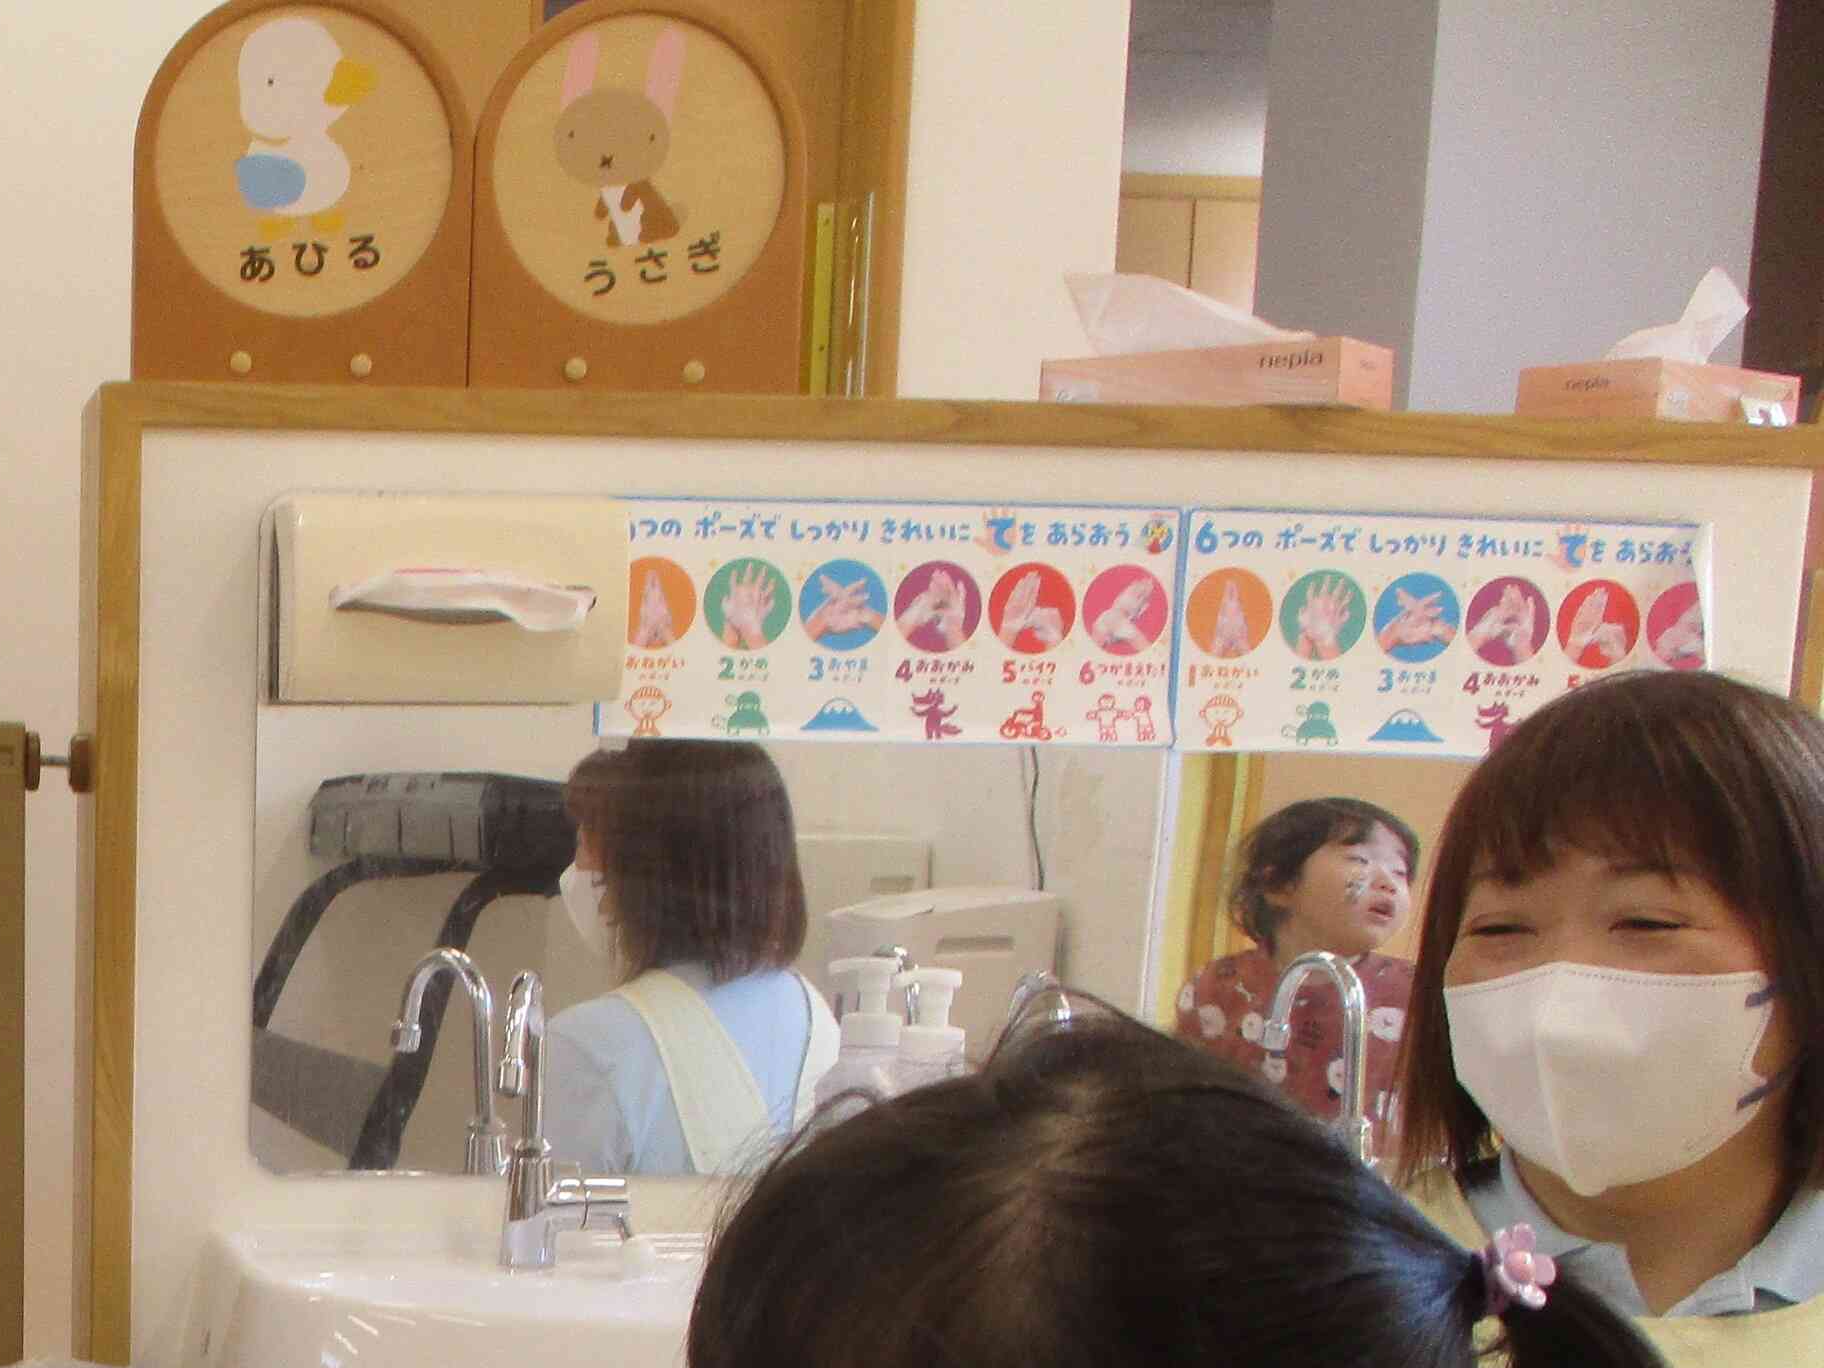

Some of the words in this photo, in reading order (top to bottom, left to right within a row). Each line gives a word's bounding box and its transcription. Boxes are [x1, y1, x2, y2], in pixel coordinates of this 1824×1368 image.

[239, 234, 382, 283] あひる
[583, 230, 722, 297] うさぎ
[629, 518, 682, 541] つの
[694, 511, 782, 540] ポーズで
[789, 518, 871, 542] しっかり
[880, 516, 970, 544] きれいに
[1046, 521, 1130, 547] あらおう
[1195, 520, 1265, 554] 6つの
[1275, 523, 1362, 552] ポーズで
[1368, 533, 1448, 556] しっかり
[1457, 533, 1544, 559] きれいに
[718, 656, 735, 681] 2
[808, 656, 825, 681] 3
[895, 660, 913, 682] 4
[1002, 660, 1017, 683] 5
[1079, 661, 1095, 685] 6
[1188, 665, 1196, 688] 1
[1289, 666, 1307, 690] 2
[1377, 667, 1393, 693] 3
[1462, 671, 1480, 695] 4
